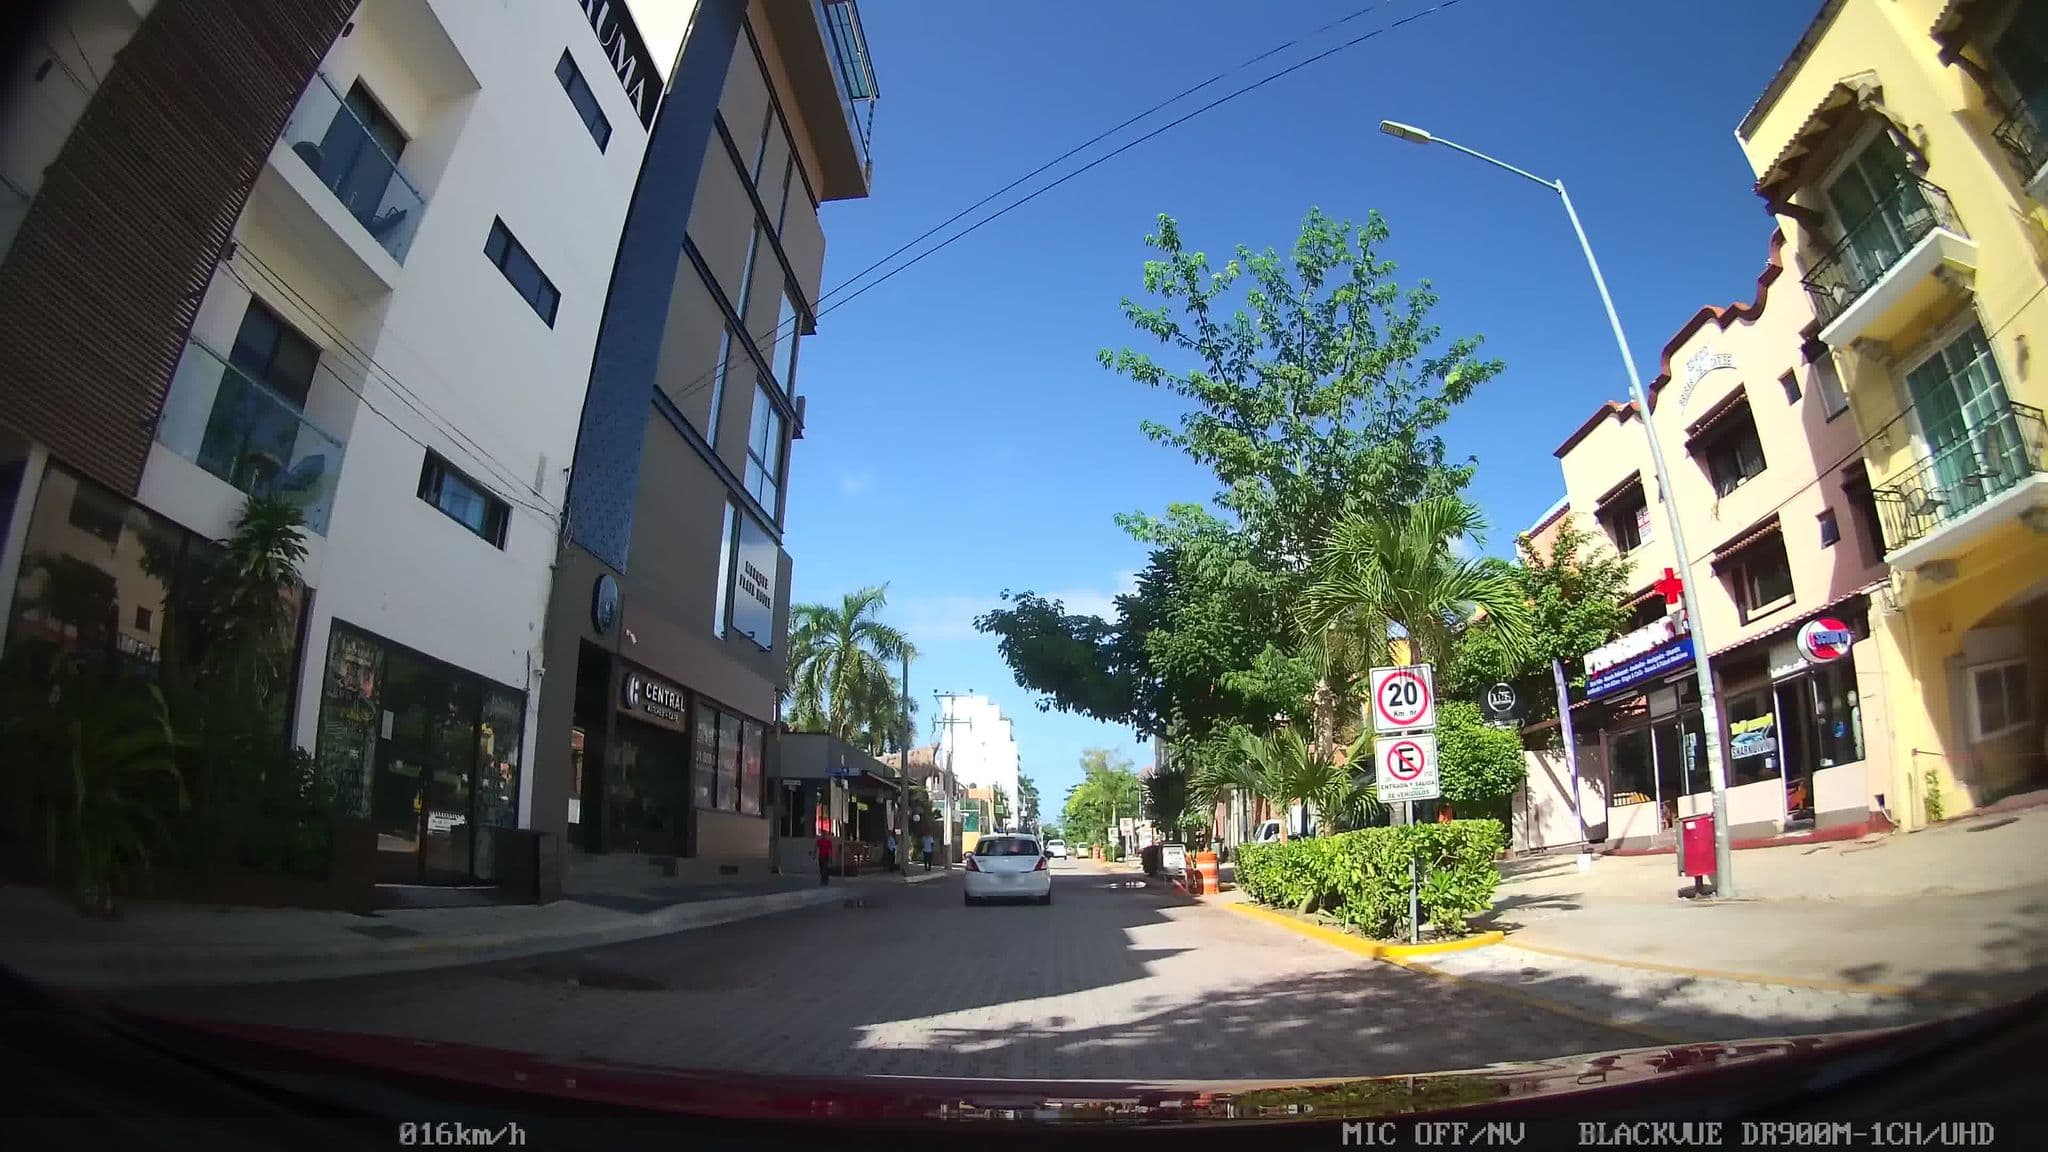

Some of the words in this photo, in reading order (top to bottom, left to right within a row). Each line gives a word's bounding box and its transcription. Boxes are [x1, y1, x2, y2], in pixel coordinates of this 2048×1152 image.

[585, 0, 645, 117] UMA
[646, 682, 685, 712] CENTRAL
[1388, 682, 1417, 707] 20
[1398, 747, 1416, 772] E
